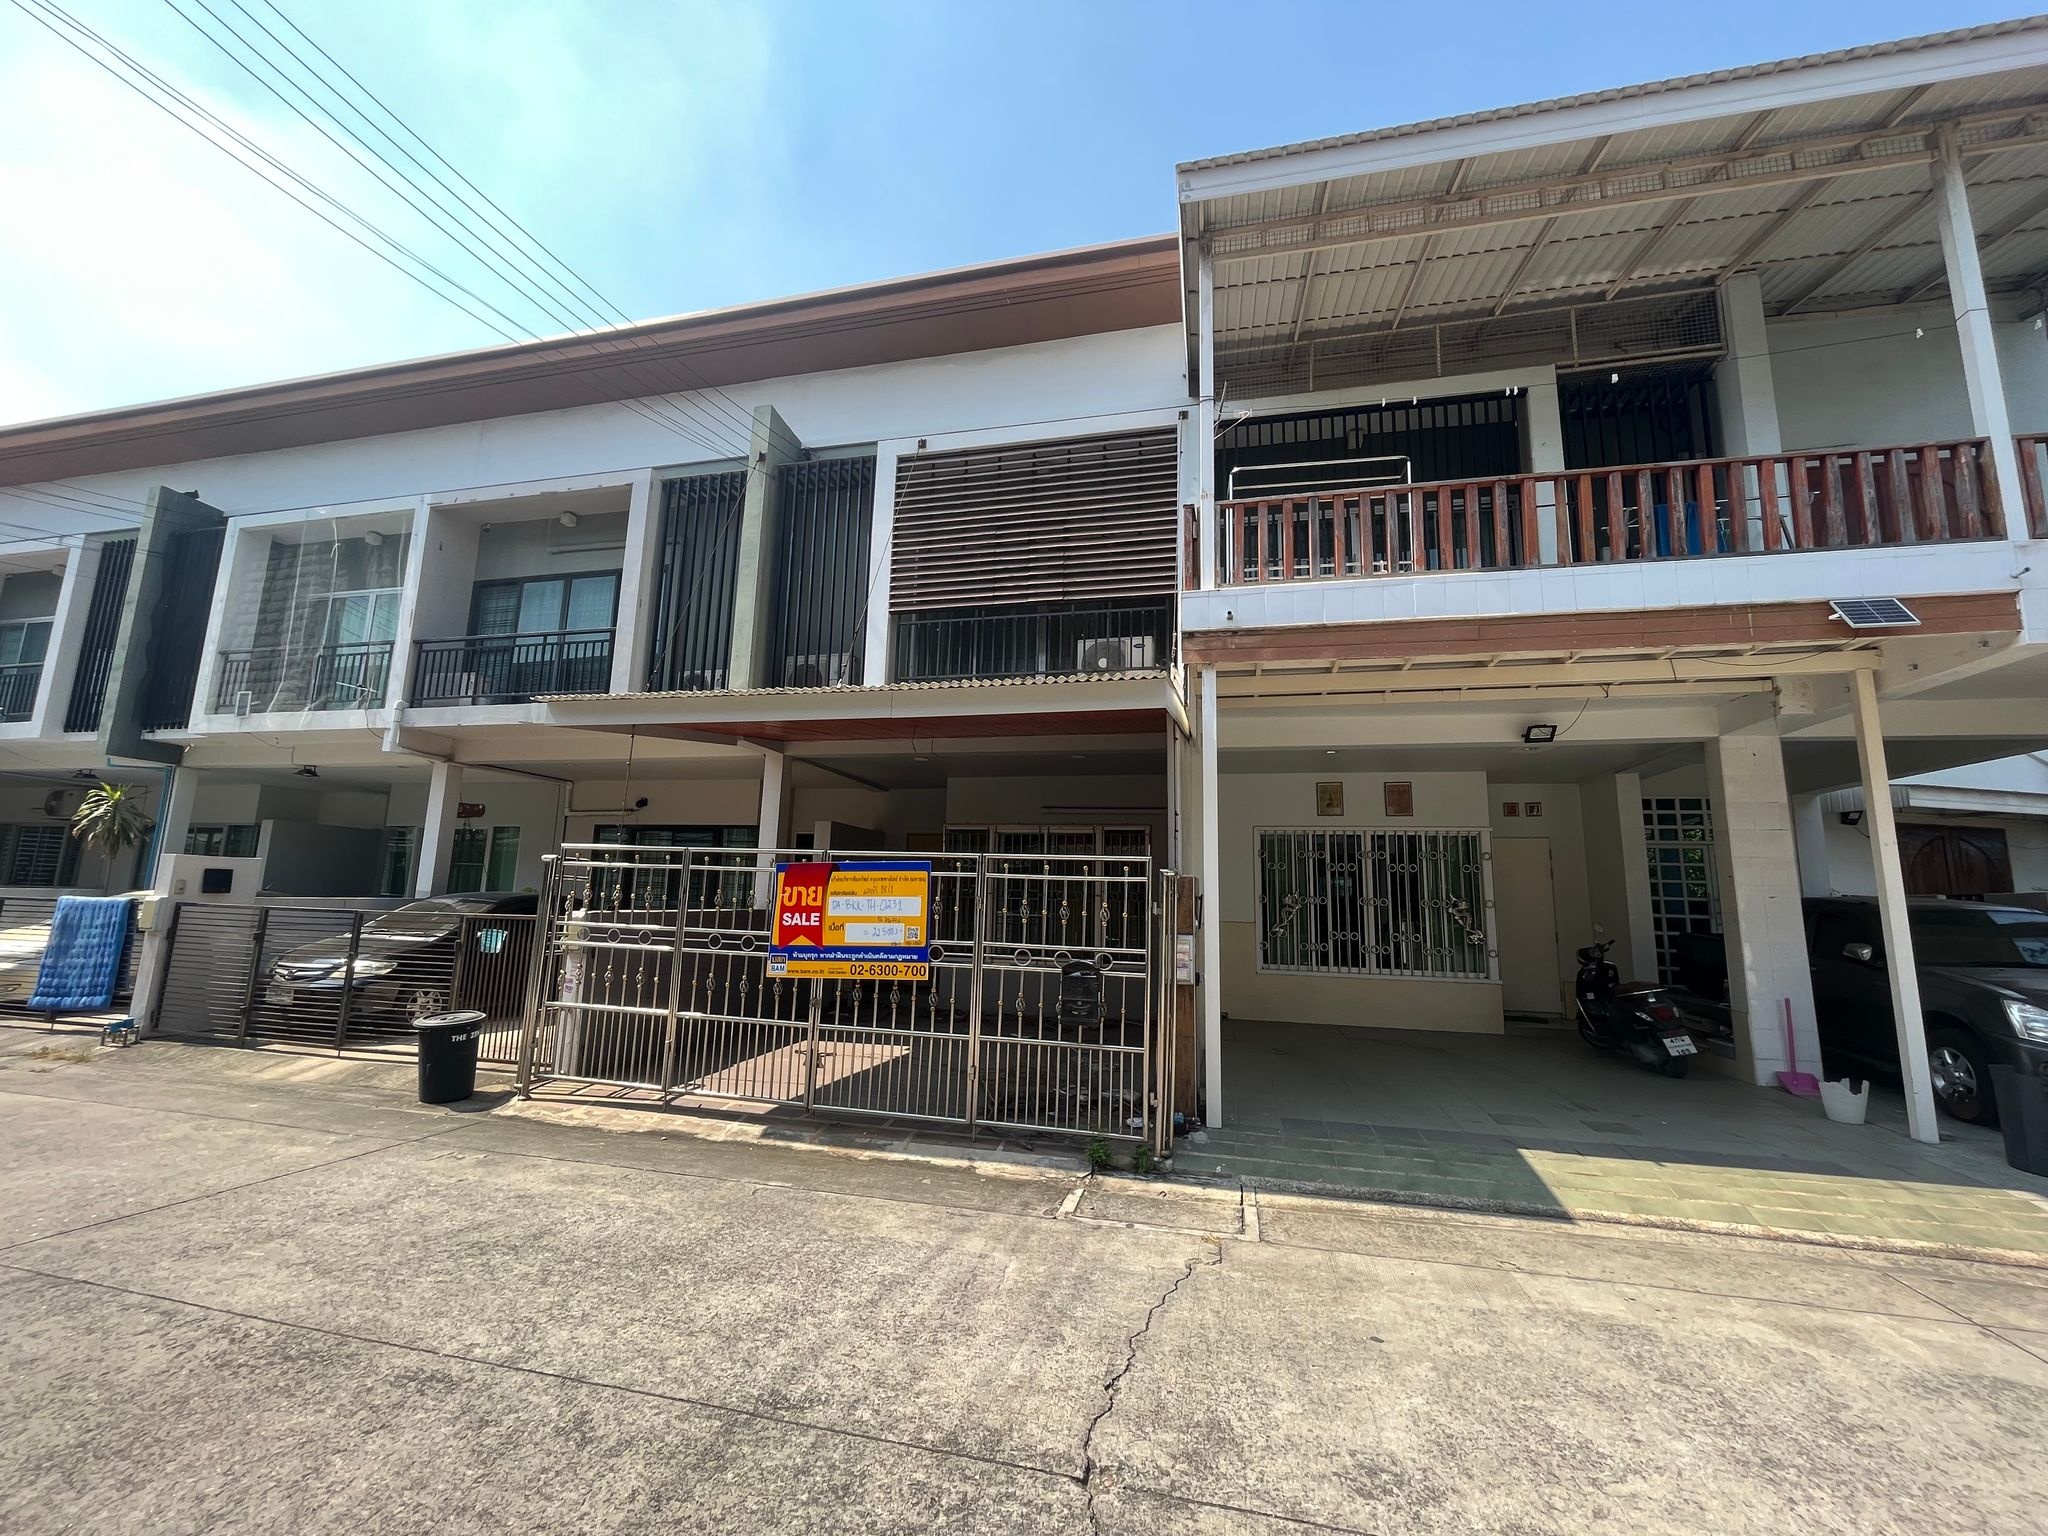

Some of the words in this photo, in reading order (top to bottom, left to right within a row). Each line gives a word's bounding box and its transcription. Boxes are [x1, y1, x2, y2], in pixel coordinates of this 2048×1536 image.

[783, 886, 823, 907] ขาย
[782, 912, 821, 926] SALE
[770, 964, 785, 972] BAM
[850, 964, 927, 977] 02-6300-700
[451, 1033, 468, 1042] THE
